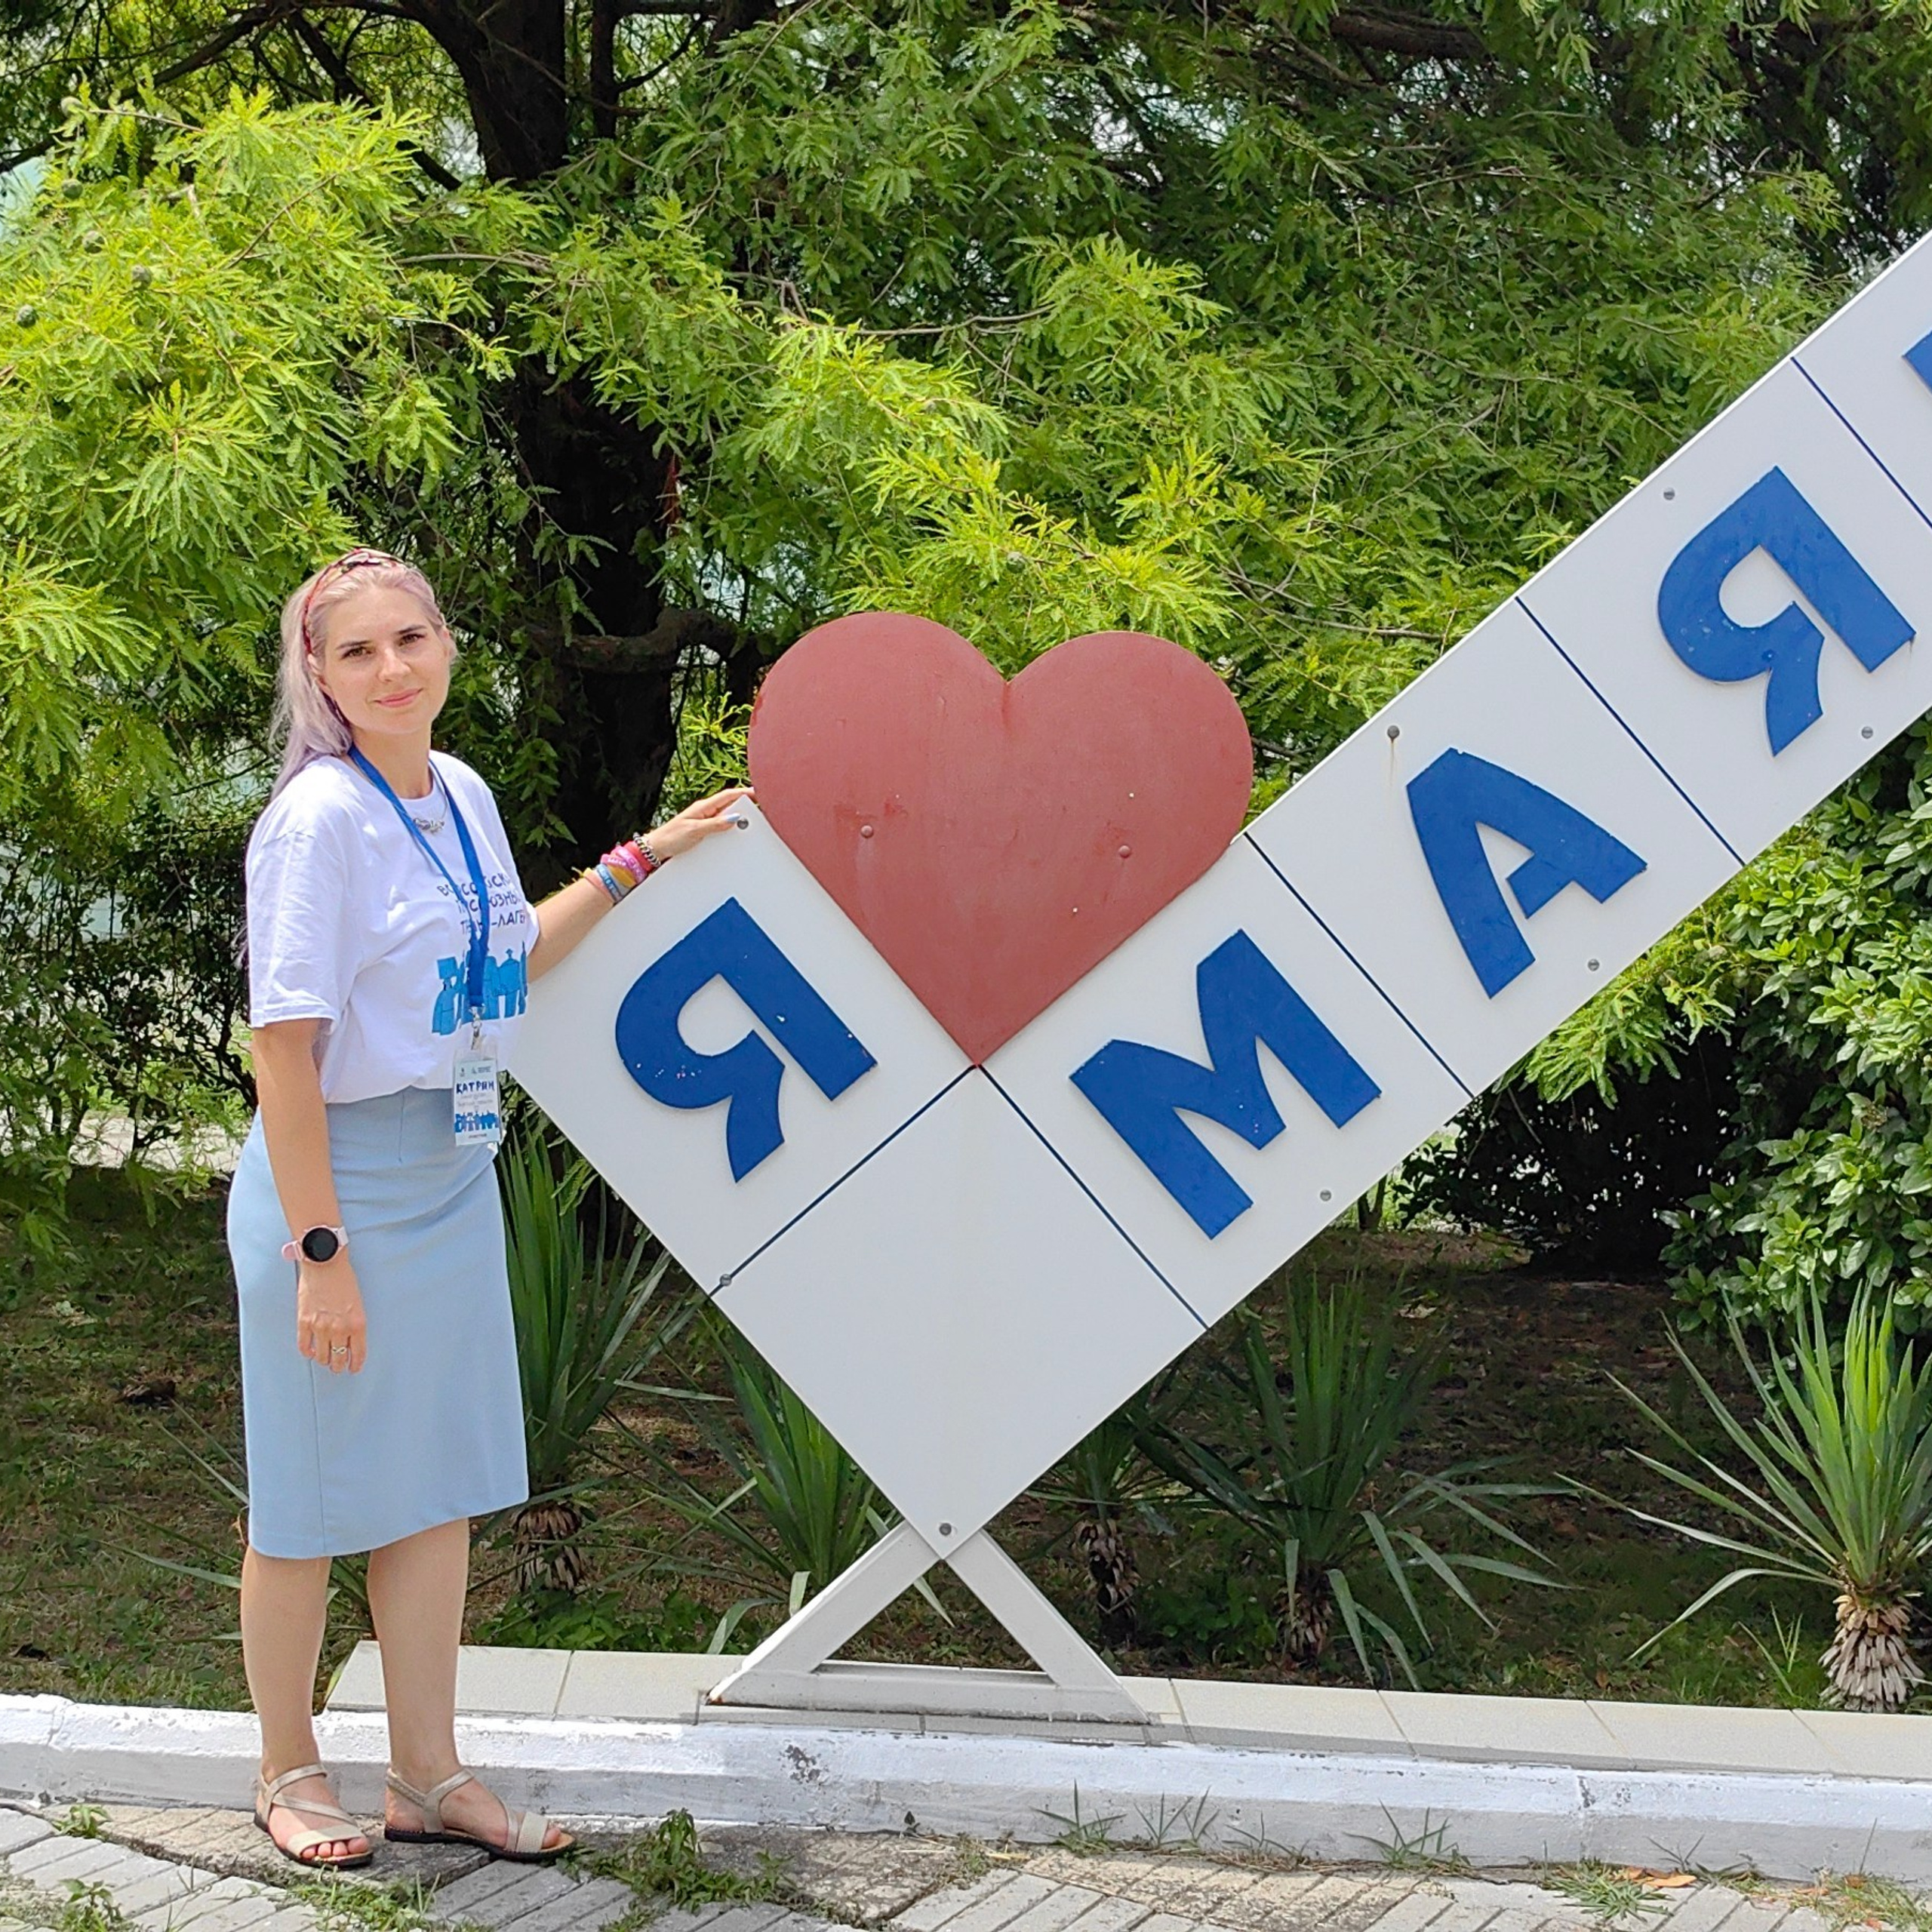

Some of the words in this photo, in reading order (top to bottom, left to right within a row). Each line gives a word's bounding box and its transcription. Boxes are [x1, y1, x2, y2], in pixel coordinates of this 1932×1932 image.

[615, 896, 878, 1183] Я
[1069, 329, 1932, 1241] МАЯ
[456, 1080, 495, 1094] КАТРИН
